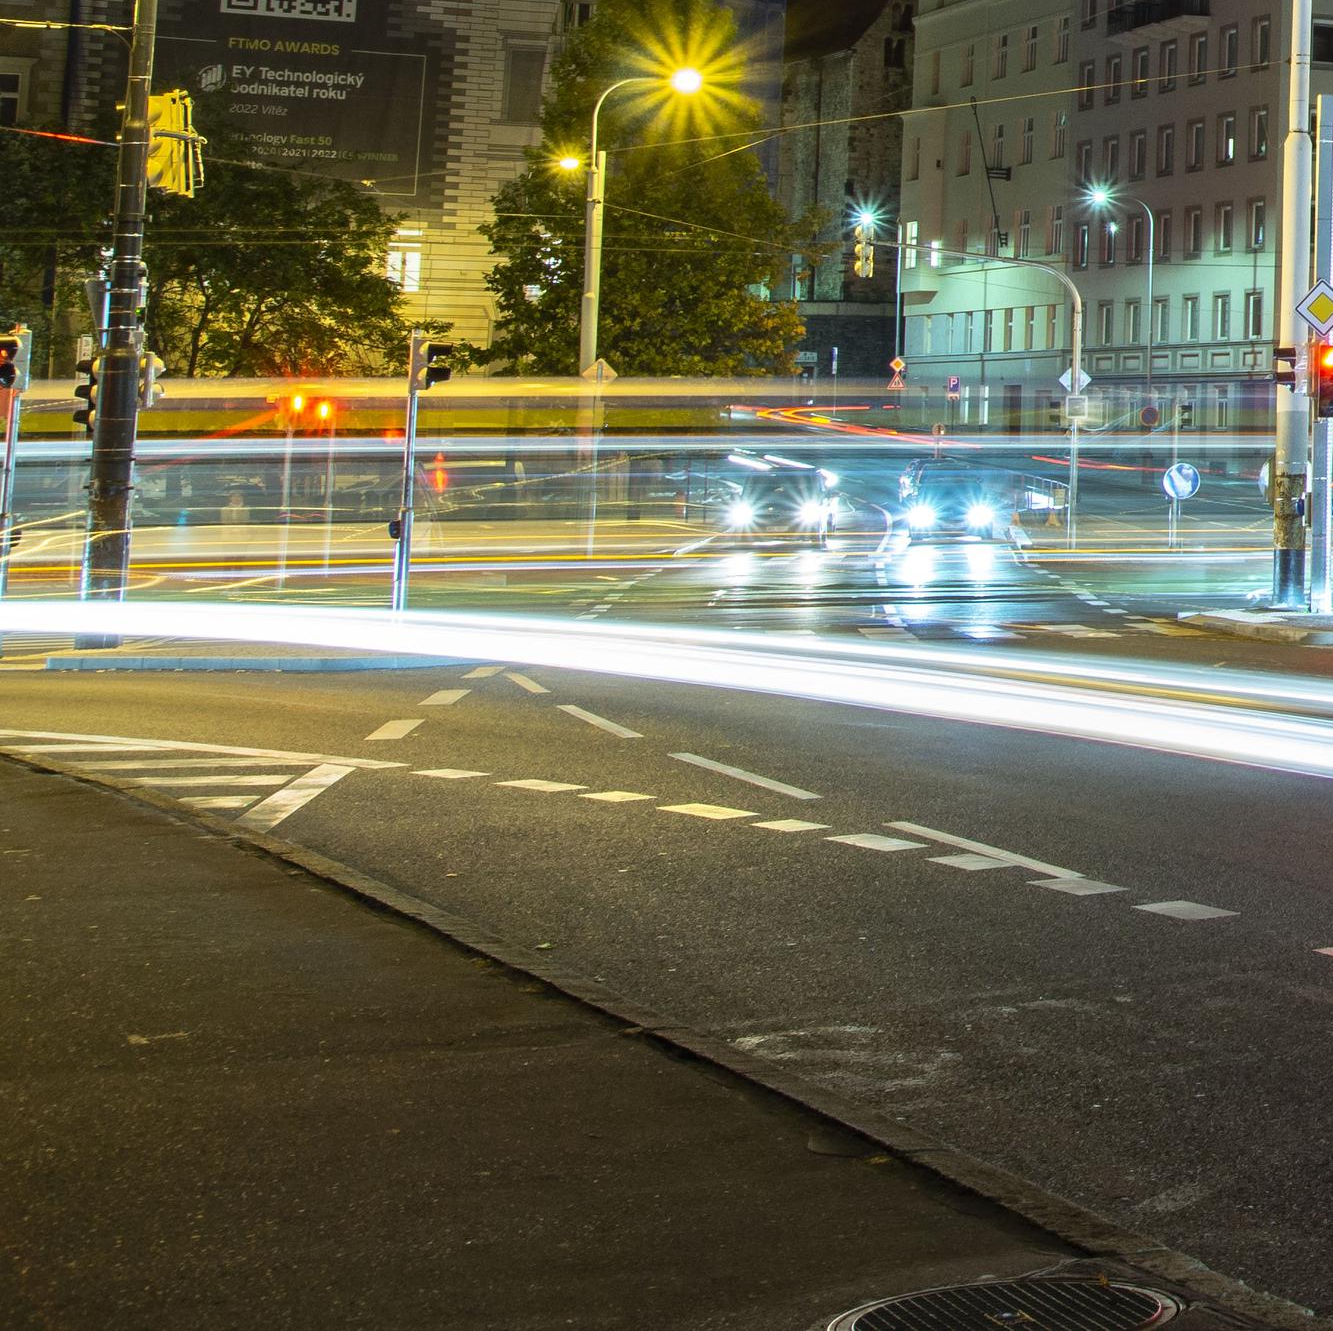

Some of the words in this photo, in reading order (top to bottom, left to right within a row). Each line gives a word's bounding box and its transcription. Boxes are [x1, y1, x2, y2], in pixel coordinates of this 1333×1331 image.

[228, 37, 271, 51] FTMO
[274, 40, 340, 56] AWARDS
[232, 65, 255, 78] EY
[259, 67, 364, 88] Technologický
[313, 87, 346, 100] roku
[229, 103, 257, 114] 2022
[290, 133, 317, 145] Fast
[318, 136, 333, 146] 50
[282, 148, 306, 157] 2021
[950, 378, 958, 388] P
